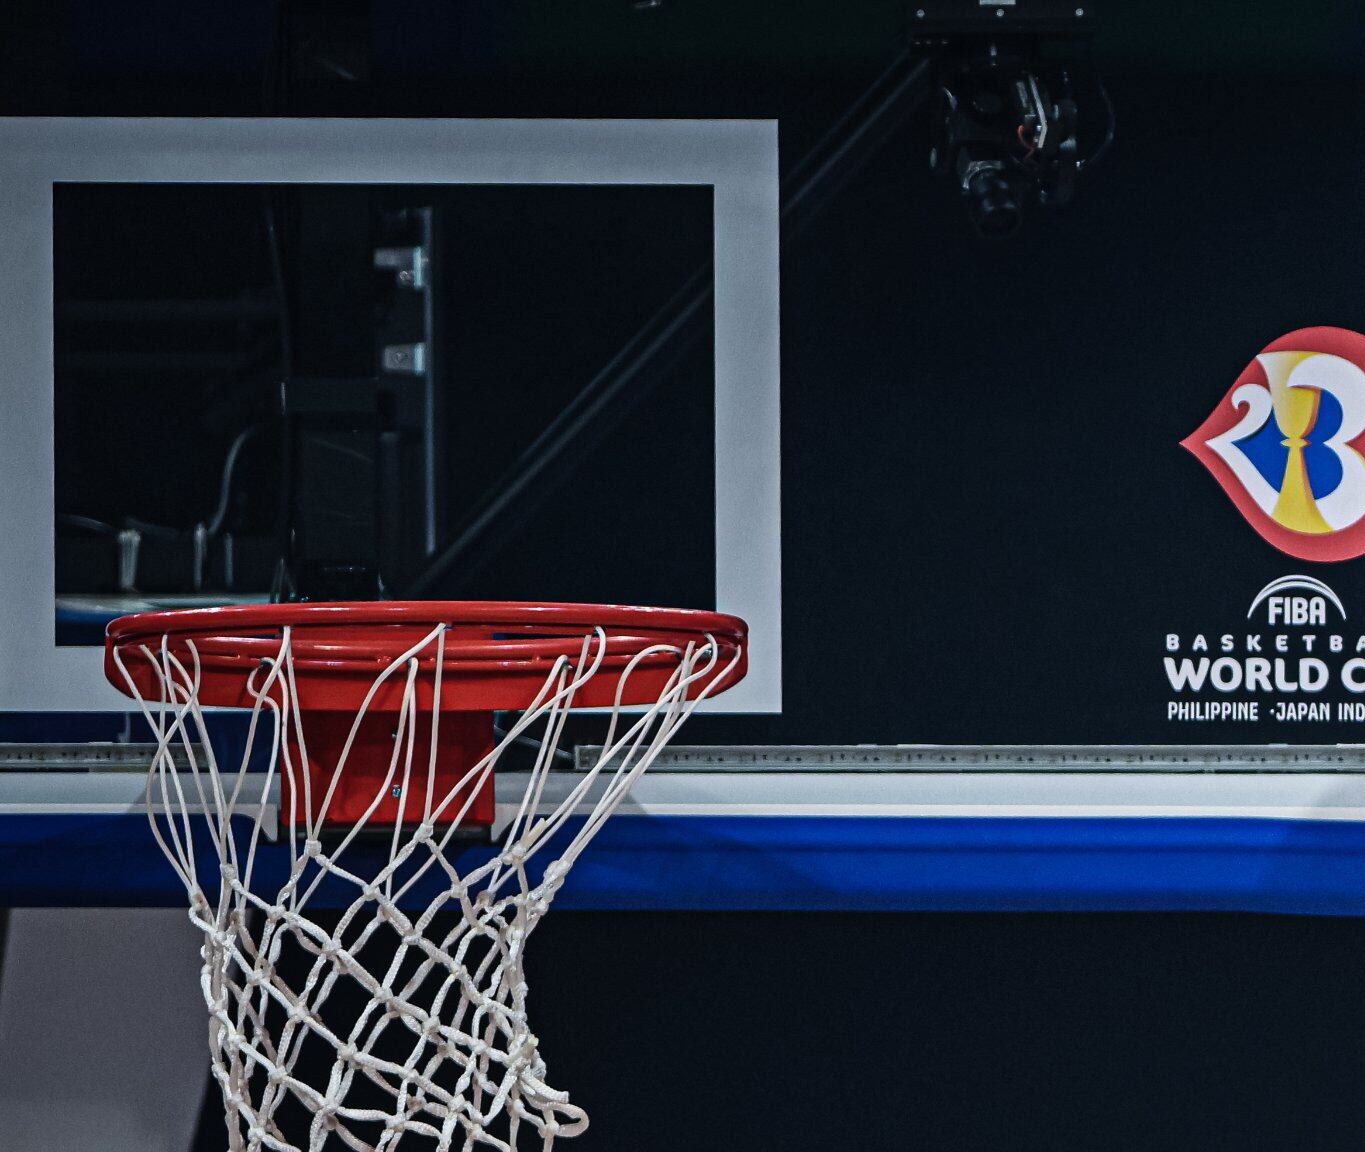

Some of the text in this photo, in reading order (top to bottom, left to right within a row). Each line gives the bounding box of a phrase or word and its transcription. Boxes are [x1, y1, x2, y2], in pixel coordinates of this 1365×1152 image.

[1268, 596, 1327, 626] FIBA
[1163, 657, 1330, 693] WORLD
[1167, 701, 1260, 721] PHILIPPINE
